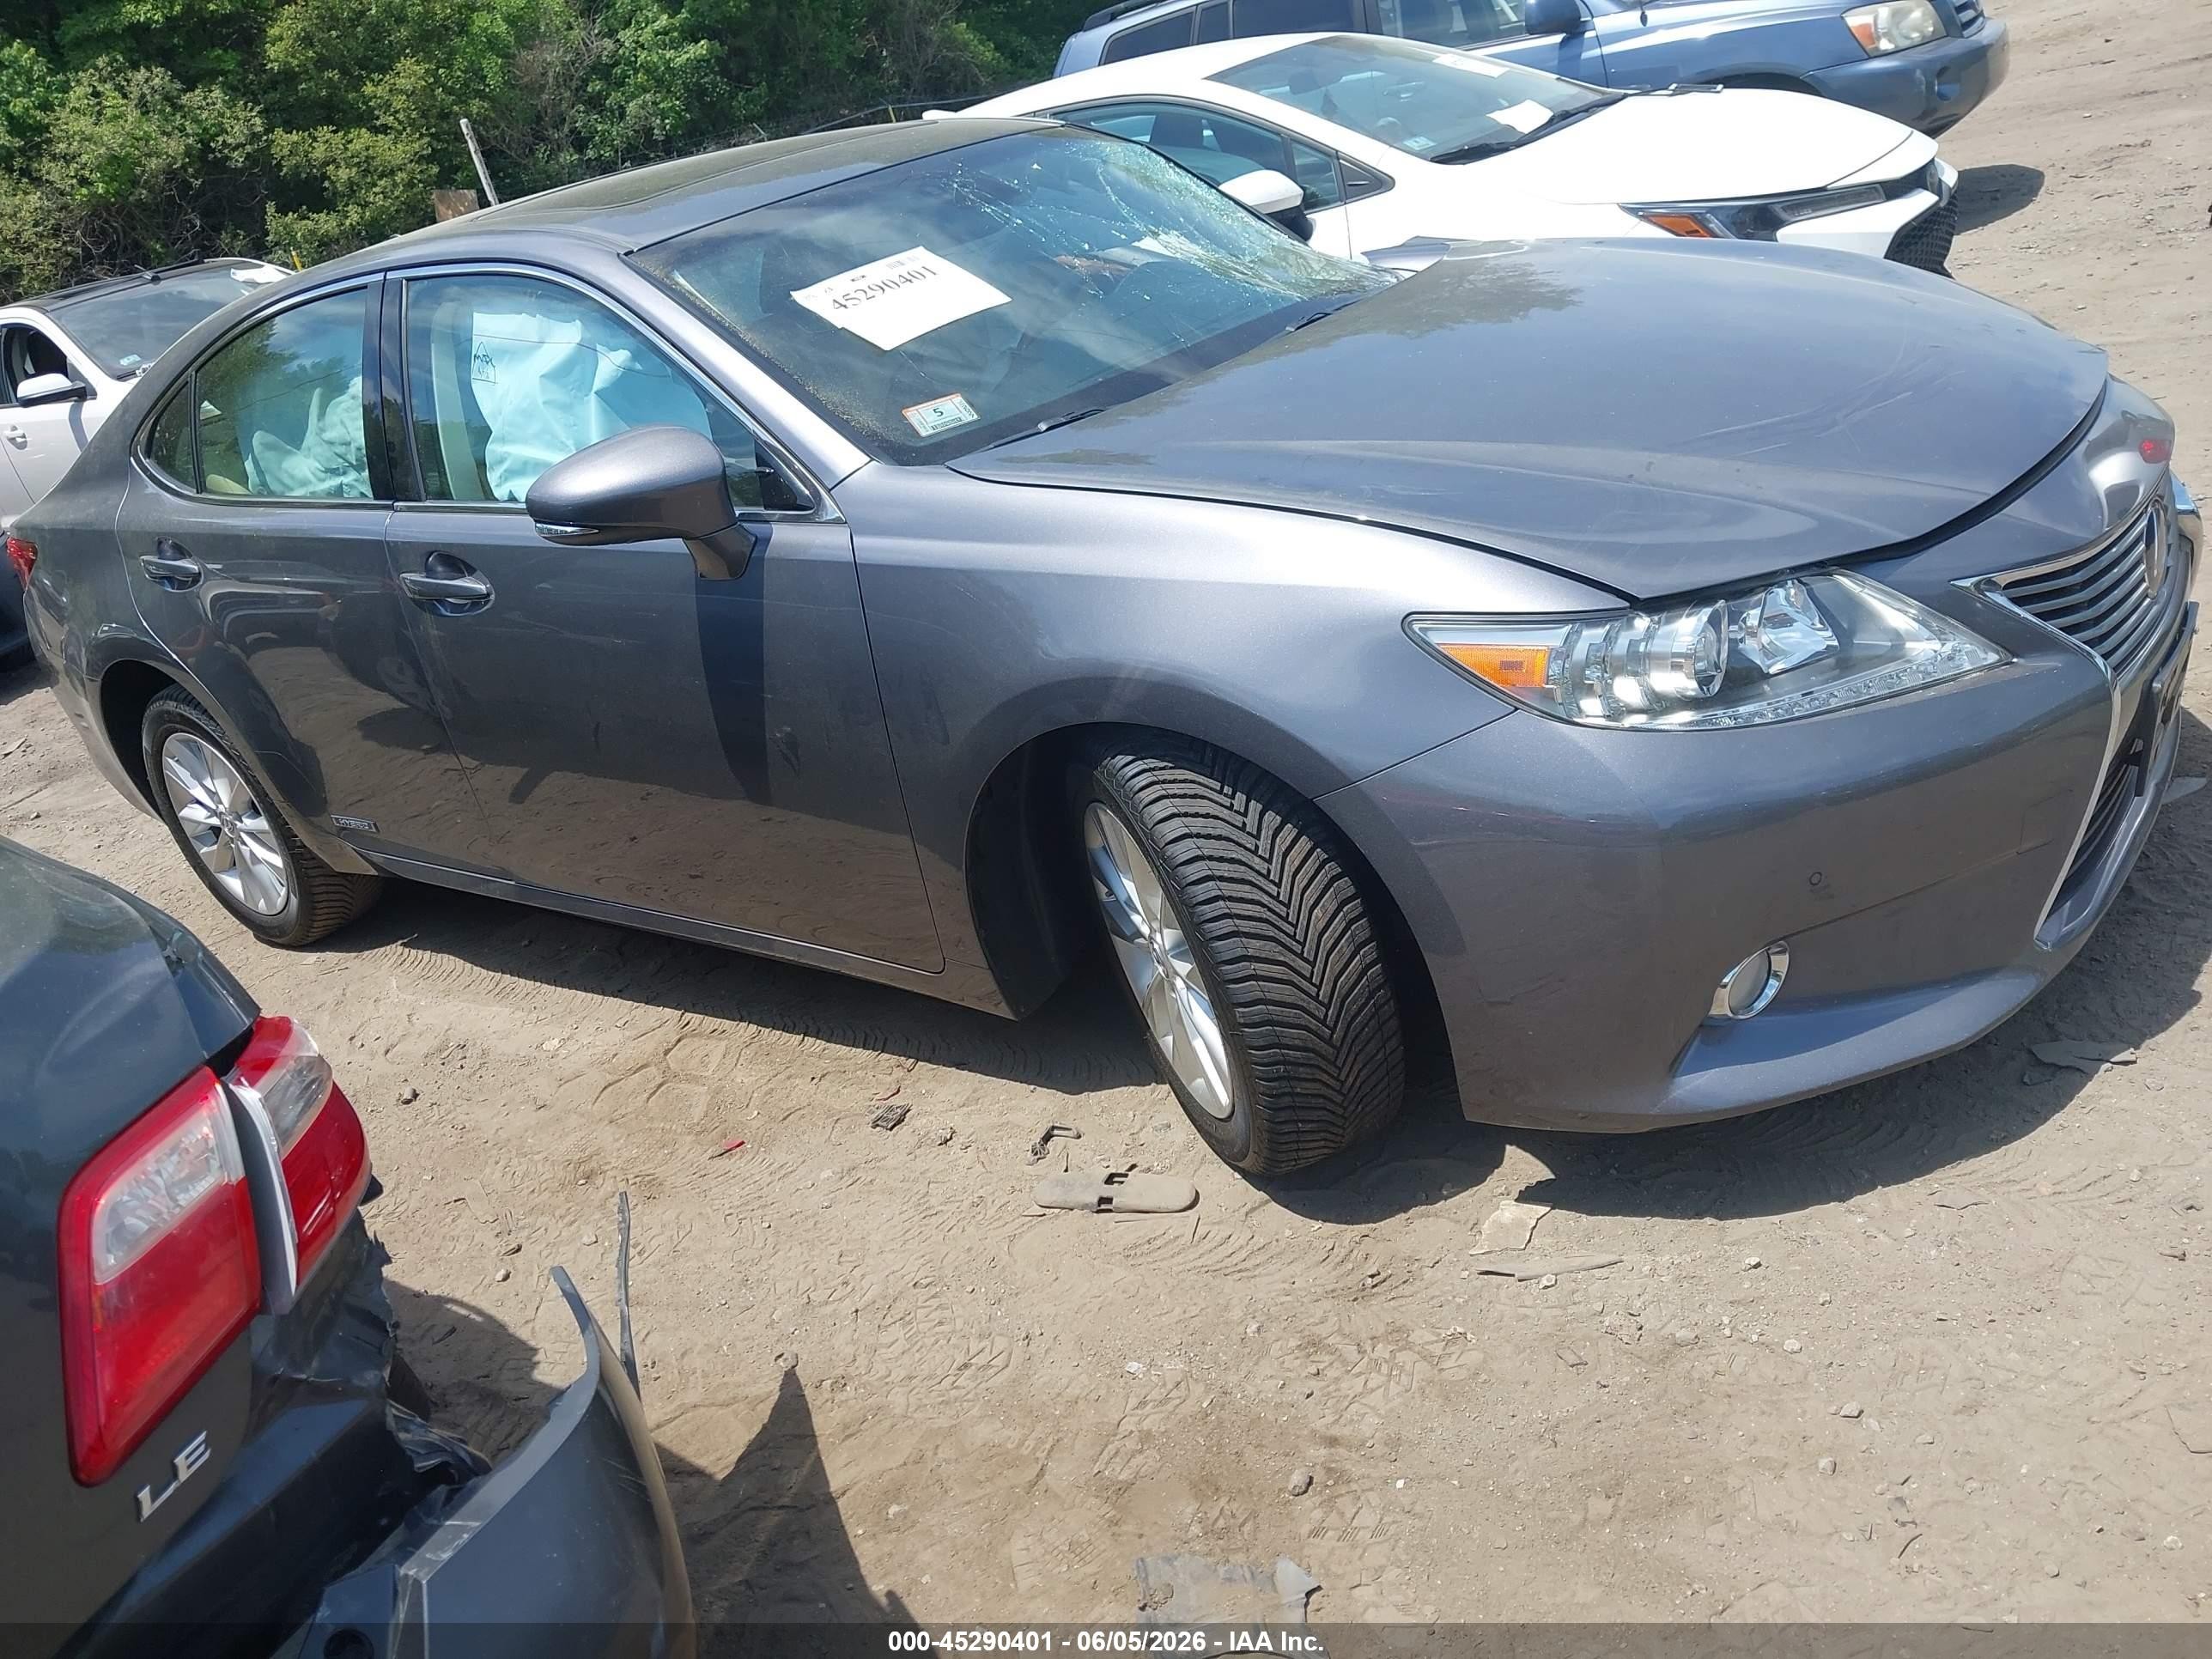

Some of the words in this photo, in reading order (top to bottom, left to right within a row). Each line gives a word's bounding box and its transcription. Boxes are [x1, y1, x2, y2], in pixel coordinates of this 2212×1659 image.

[832, 265, 939, 311] 45290401
[933, 407, 945, 417] 5
[137, 1430, 212, 1522] LE
